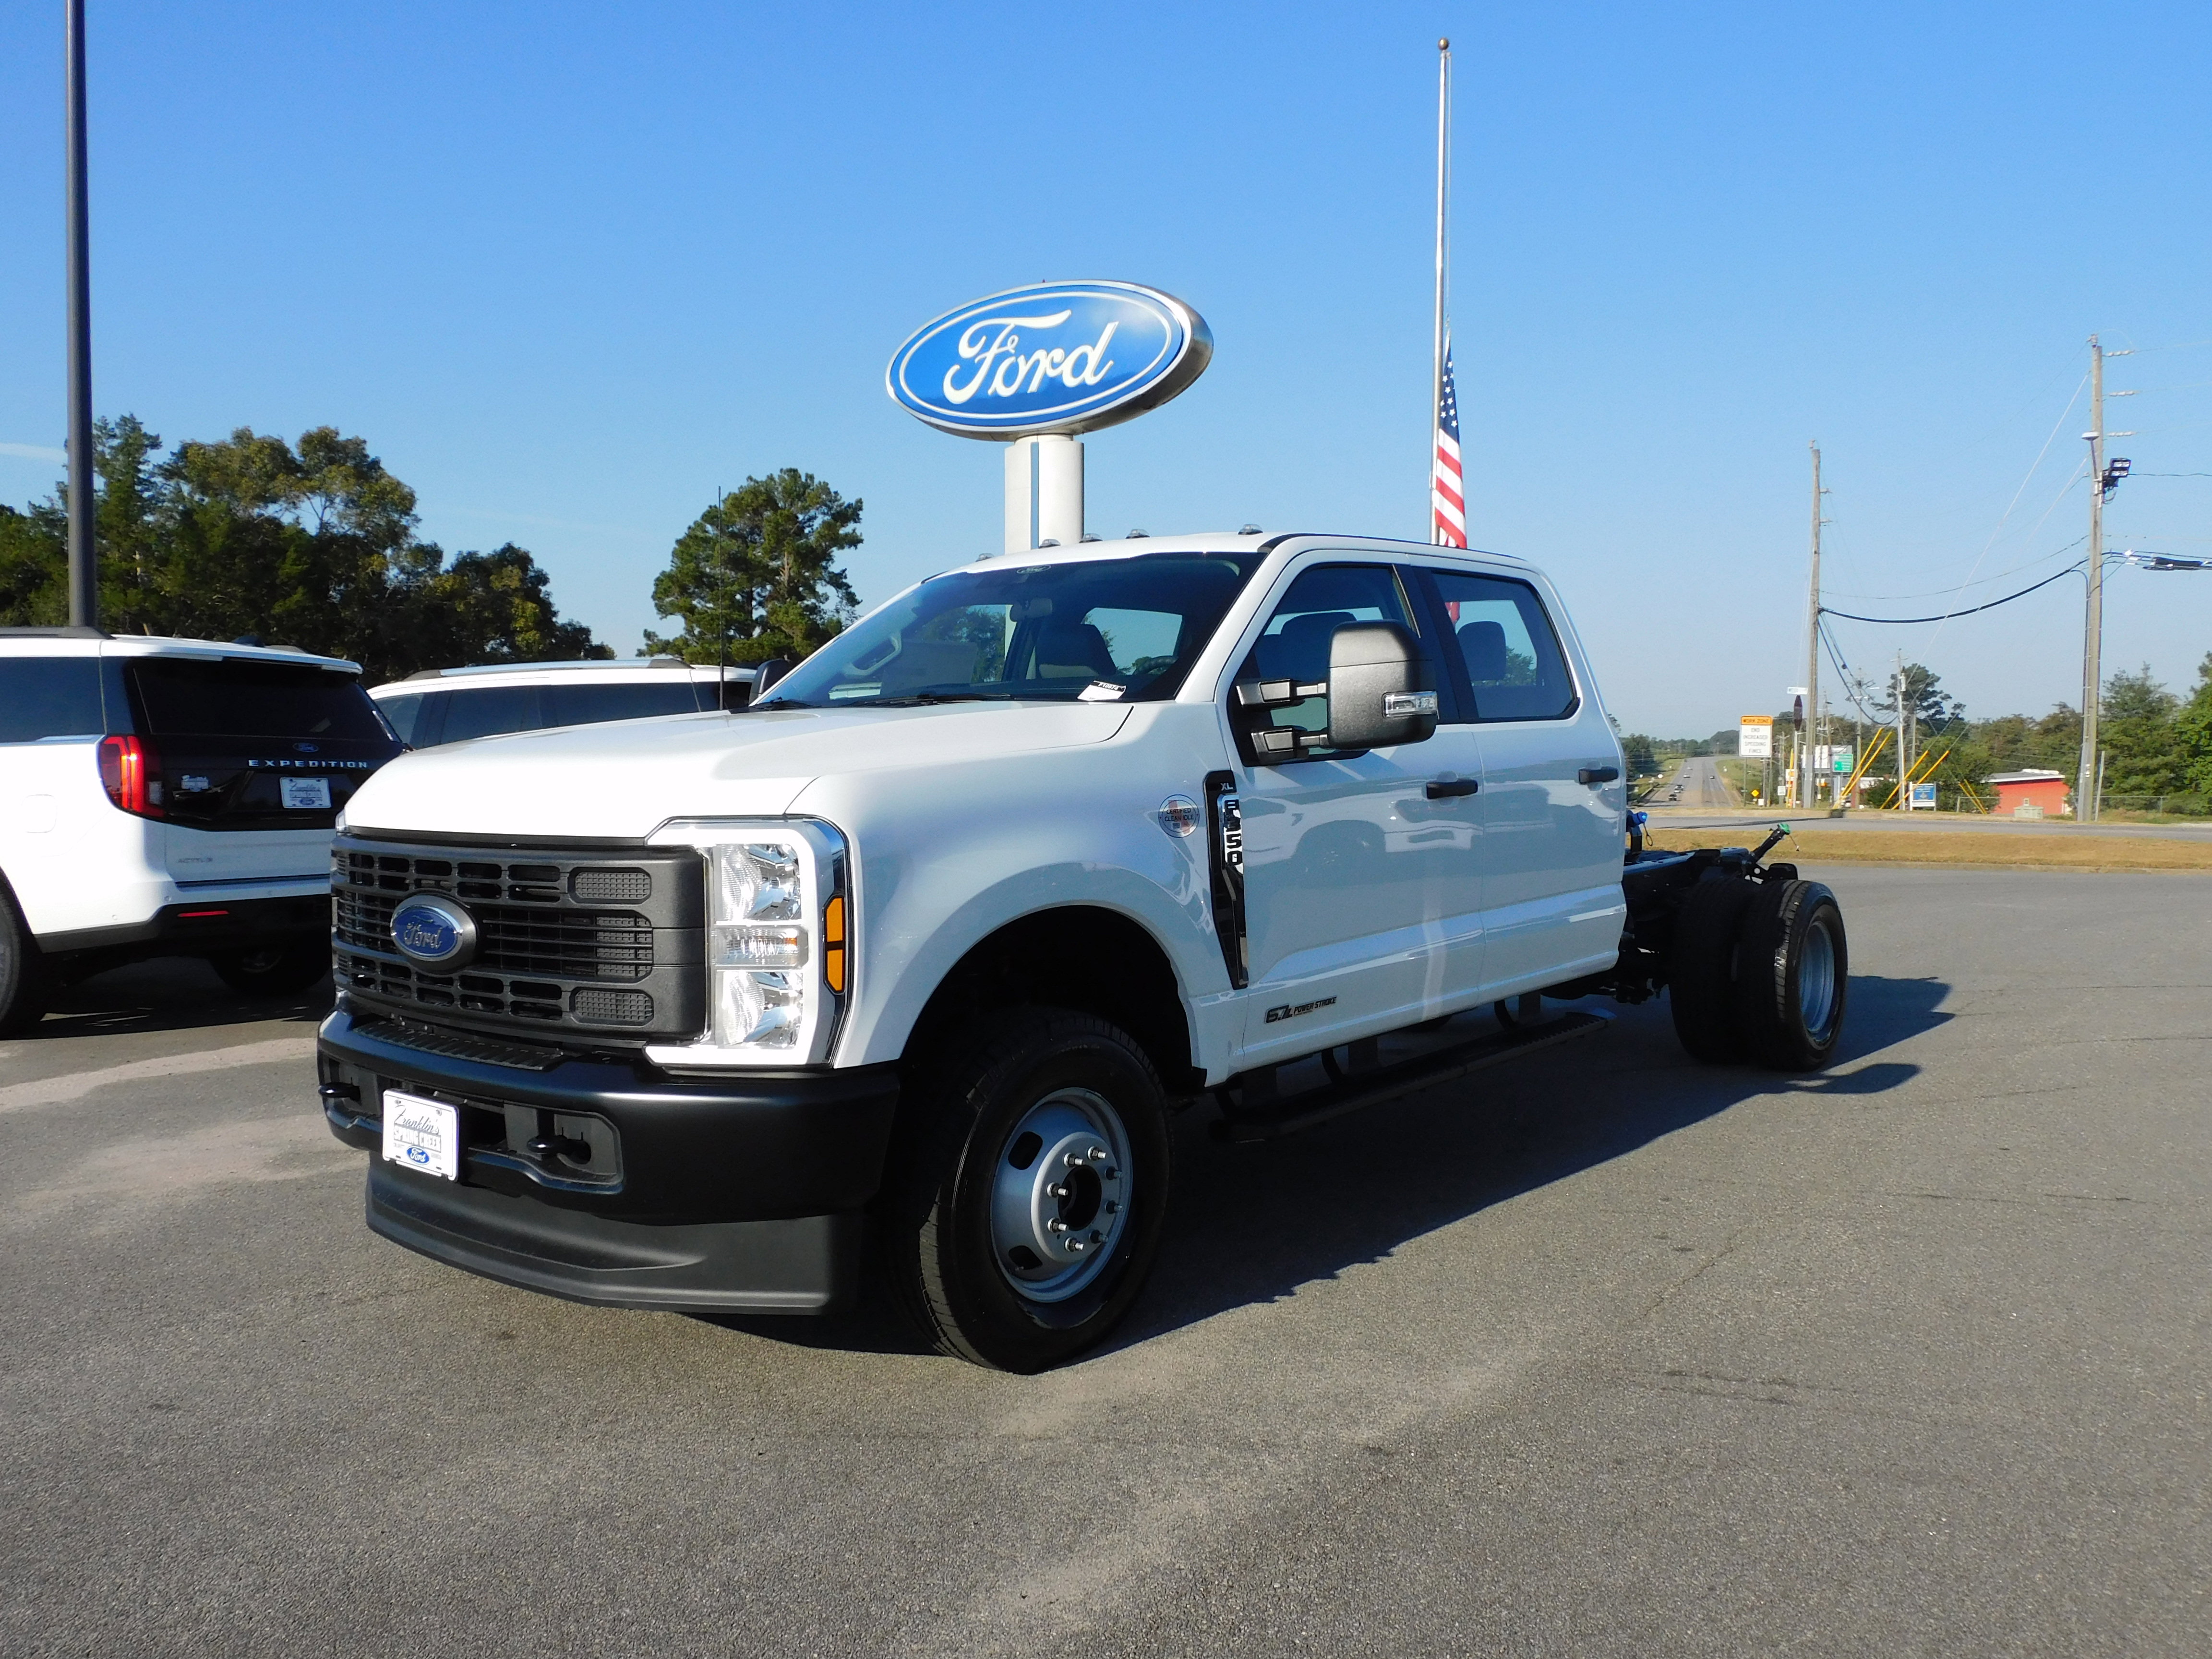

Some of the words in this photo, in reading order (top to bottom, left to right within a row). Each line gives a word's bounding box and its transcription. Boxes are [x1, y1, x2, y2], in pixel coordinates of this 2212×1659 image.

[943, 310, 1119, 404] Ford
[248, 759, 369, 768] EXPEDITION
[1220, 782, 1233, 791] XL
[403, 915, 443, 949] Ford
[1294, 1003, 1314, 1014] POWER
[1315, 997, 1337, 1008] STROKE
[394, 1105, 440, 1135] Franklin's
[394, 1127, 419, 1145] SPRING
[419, 1132, 441, 1152] CREEK
[410, 1148, 426, 1162] Ford
